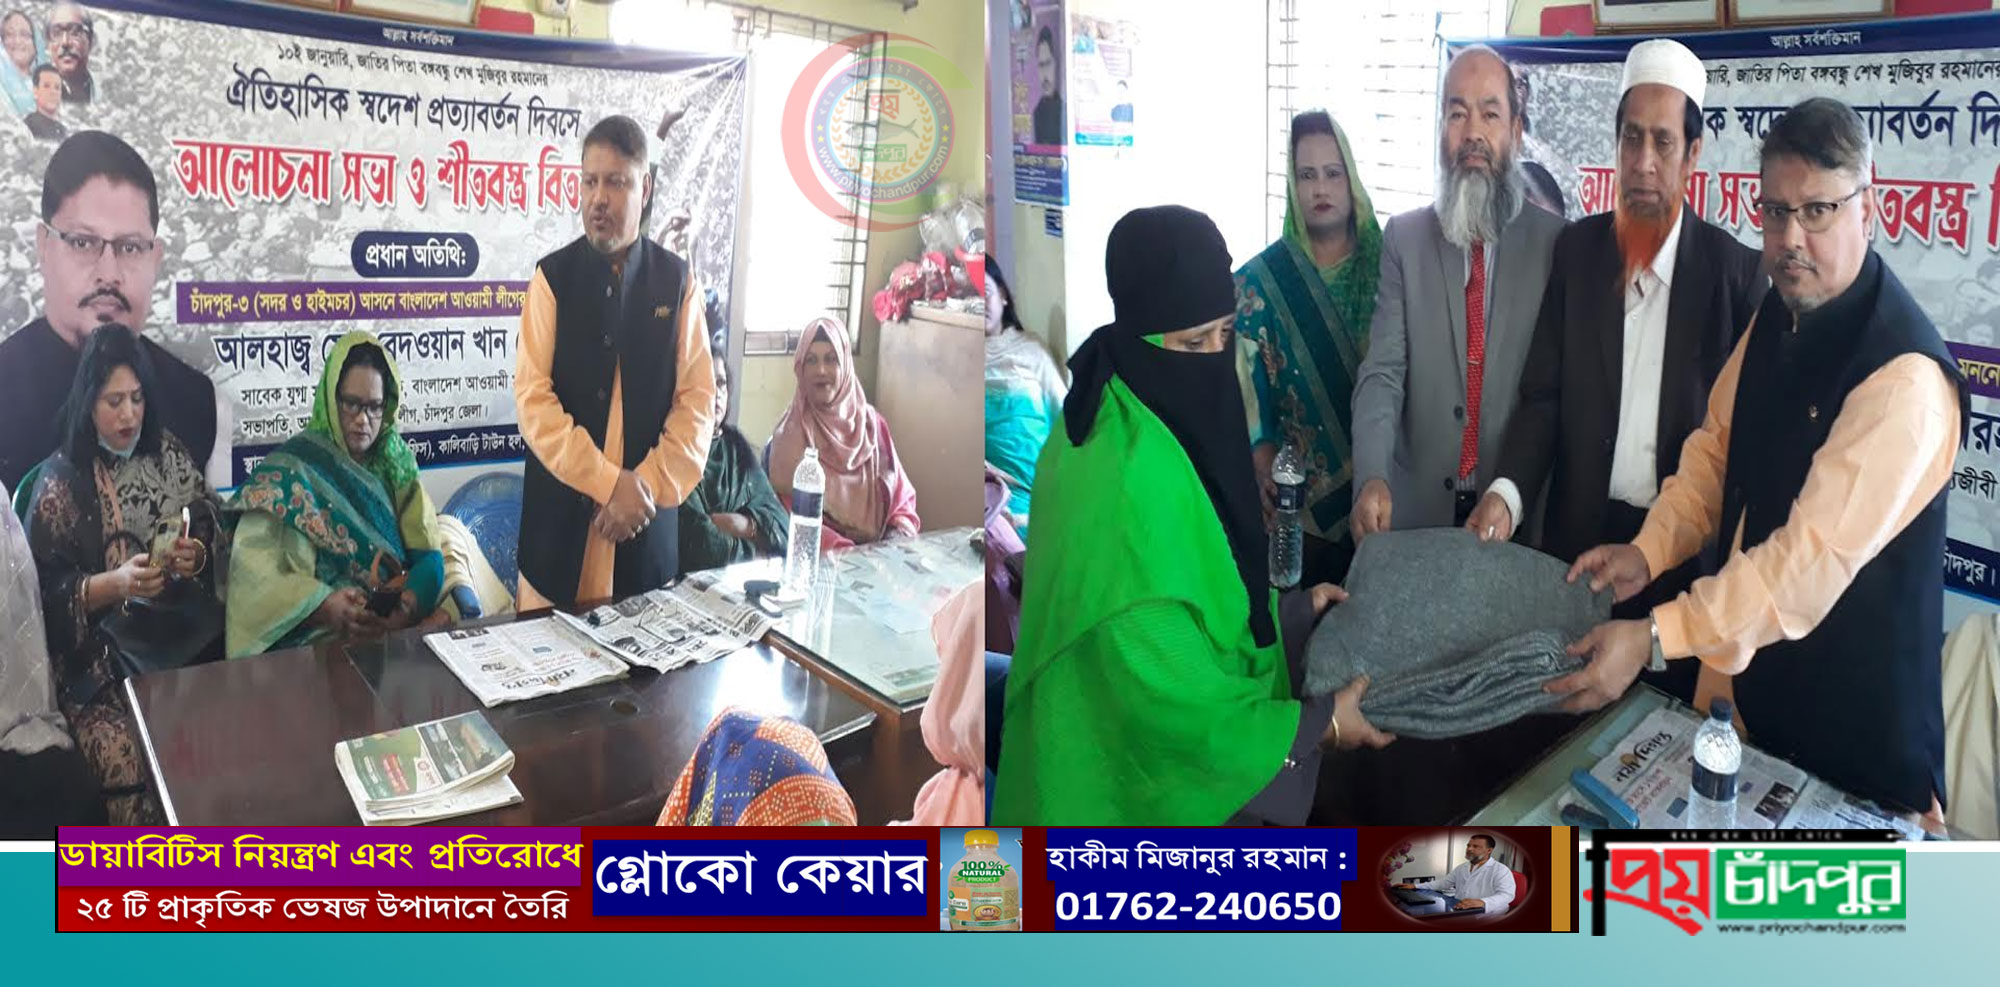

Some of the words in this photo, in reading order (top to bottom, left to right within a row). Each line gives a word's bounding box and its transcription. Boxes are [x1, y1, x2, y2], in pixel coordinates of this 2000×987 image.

[1770, 35, 1801, 49] আল্লাহ
[1803, 31, 1861, 47] সর্বশক্তিমান
[278, 45, 303, 63] ১০ই
[307, 46, 353, 70] জানুয়ারি,
[357, 50, 389, 71] জাতির
[393, 53, 416, 75] পিতা
[420, 60, 450, 81] বঙ্গবন্ধু
[454, 65, 474, 80] শেখ
[477, 65, 507, 84] মুজিবুর
[509, 71, 548, 87] রহমানের
[1737, 63, 1773, 83] জাতির
[1776, 62, 1807, 83] পিতা
[1810, 64, 1848, 87] বঙ্গবন্ধু
[1853, 63, 1882, 82] শেখ
[1885, 58, 1935, 86] মুজিবুর
[227, 61, 351, 124] ঐতিহাসিক
[357, 89, 421, 127] স্বদেশ
[427, 92, 521, 135] প্রত্যাবর্তন
[526, 95, 582, 138] দিবসে
[172, 139, 332, 207] আলোচনা
[341, 152, 397, 204] সভা
[407, 157, 427, 206] ও
[437, 140, 530, 212] শীতবস্ত্র
[365, 240, 408, 269] প্রধান
[412, 239, 466, 267] অতিথি:
[190, 288, 249, 317] চাঁদপুর-৩
[253, 293, 287, 317] (সদর
[291, 294, 302, 311] ও
[305, 287, 356, 316] হাইমচর)
[359, 290, 397, 312] আসনে
[398, 289, 447, 312] বাংলাদেশ
[450, 285, 493, 311] আওয়ামী
[213, 332, 312, 377] আলহাজ্ব
[472, 326, 508, 361] খান
[241, 387, 282, 406] সাবেক
[286, 384, 308, 407] যুগ্ম
[412, 376, 461, 398] বাংলাদেশ
[465, 369, 509, 392] আওয়ামী
[242, 413, 292, 435] সভাপতি,
[424, 403, 455, 425] চাঁদপুর
[438, 432, 480, 455] কালিবাড়ি
[482, 431, 505, 450] টাউন
[507, 434, 526, 451] হল,
